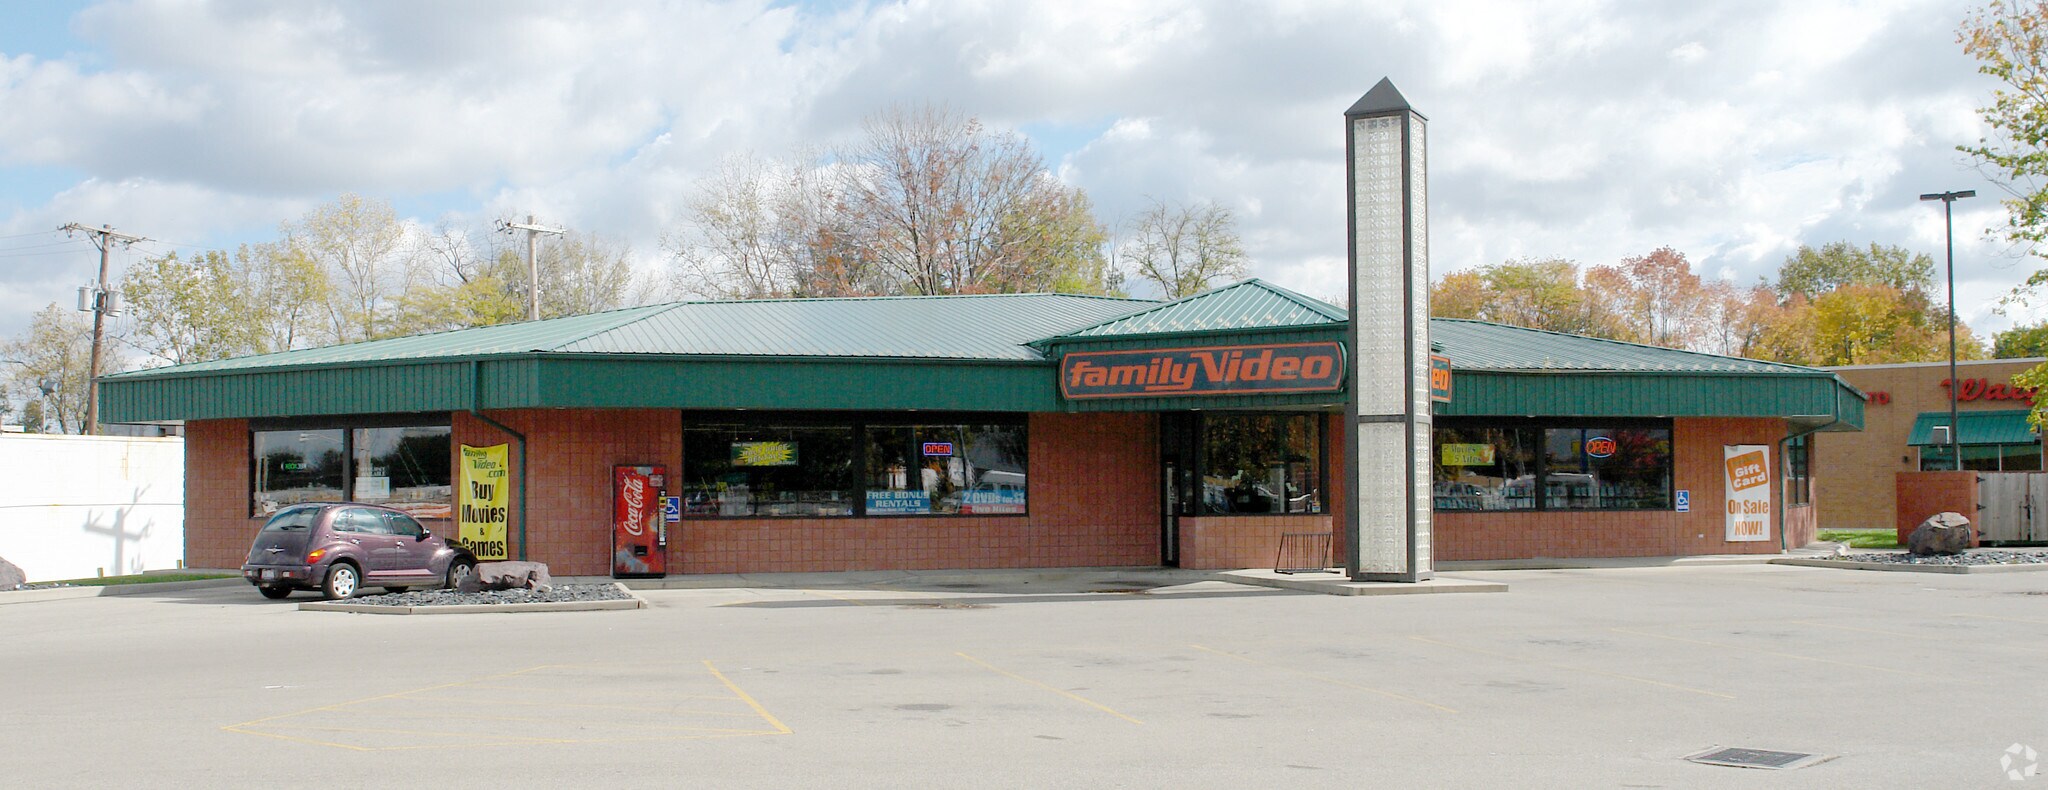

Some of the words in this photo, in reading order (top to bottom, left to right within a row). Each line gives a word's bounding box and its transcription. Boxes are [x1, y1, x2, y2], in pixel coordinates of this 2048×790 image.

[1190, 350, 1334, 382] Video
[925, 444, 950, 454] OPEN
[1586, 440, 1617, 454] OPEN
[1735, 463, 1760, 477] Gift
[1733, 472, 1766, 488] Card
[471, 480, 494, 501] Buy
[867, 491, 891, 500] FREE
[894, 491, 930, 499] BONUS
[963, 492, 970, 504] 2
[972, 491, 1001, 504] DVDs
[875, 500, 921, 508] RENTALS
[1727, 499, 1741, 515] On
[1743, 499, 1769, 515] Sale
[461, 504, 505, 524] Movies
[479, 527, 485, 536] &
[1734, 520, 1763, 536] NOW!
